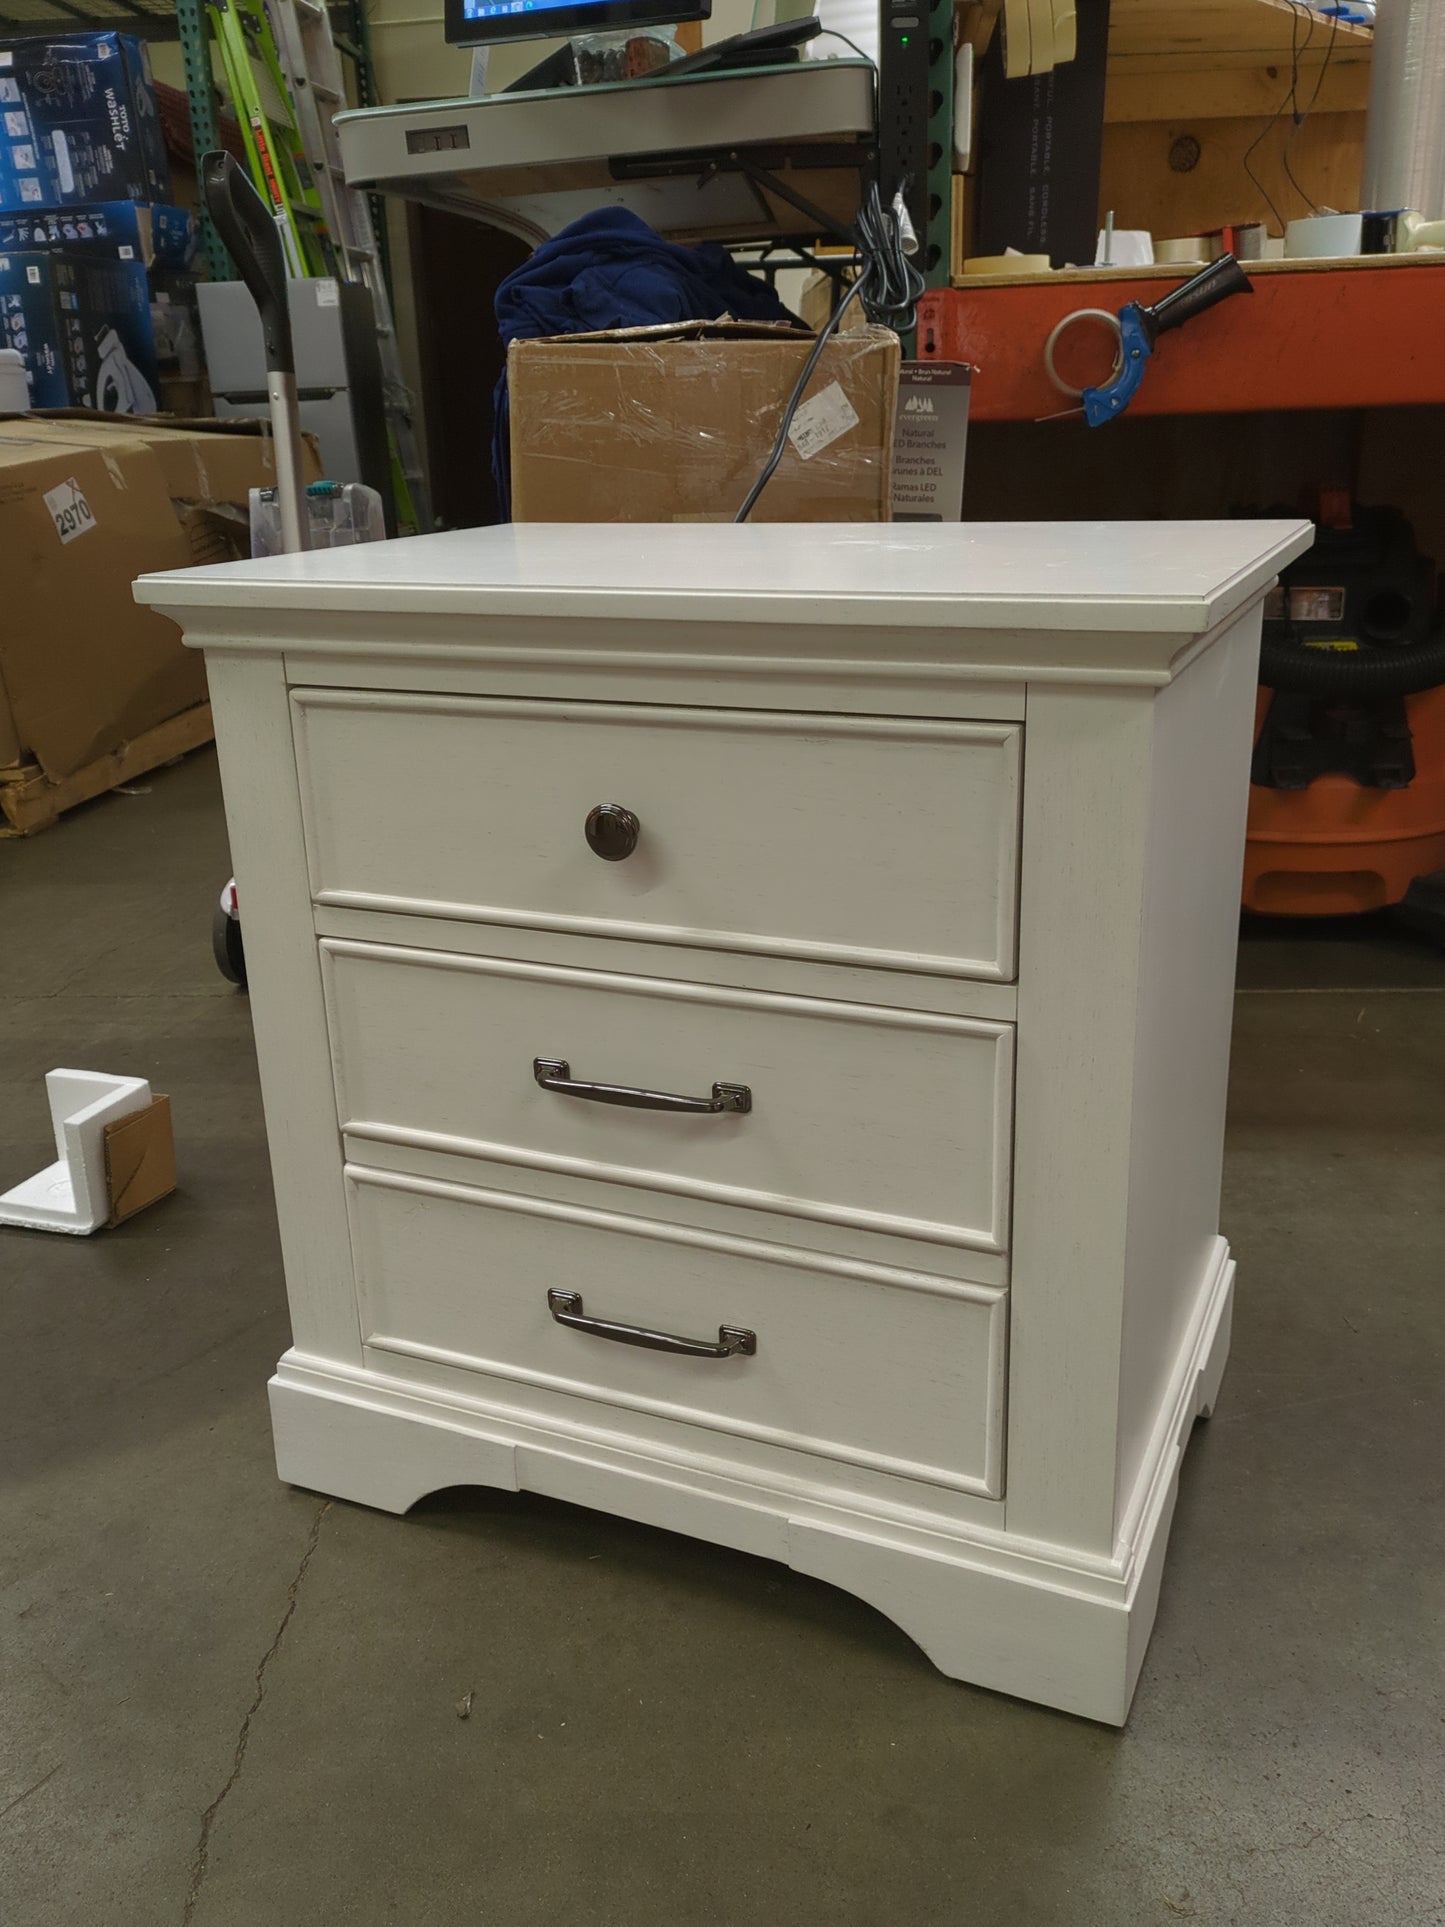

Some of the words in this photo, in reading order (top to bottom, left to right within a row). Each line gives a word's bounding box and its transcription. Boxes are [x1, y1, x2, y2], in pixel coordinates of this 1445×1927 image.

[119, 104, 131, 132] TOTO
[902, 428, 935, 438] Natural
[893, 439, 905, 448] ED
[907, 440, 947, 449] Branches
[895, 455, 935, 465] Branches
[926, 467, 943, 476] DEL
[920, 482, 937, 492] LED
[893, 493, 935, 503] Naturales
[55, 499, 91, 537] 2970
